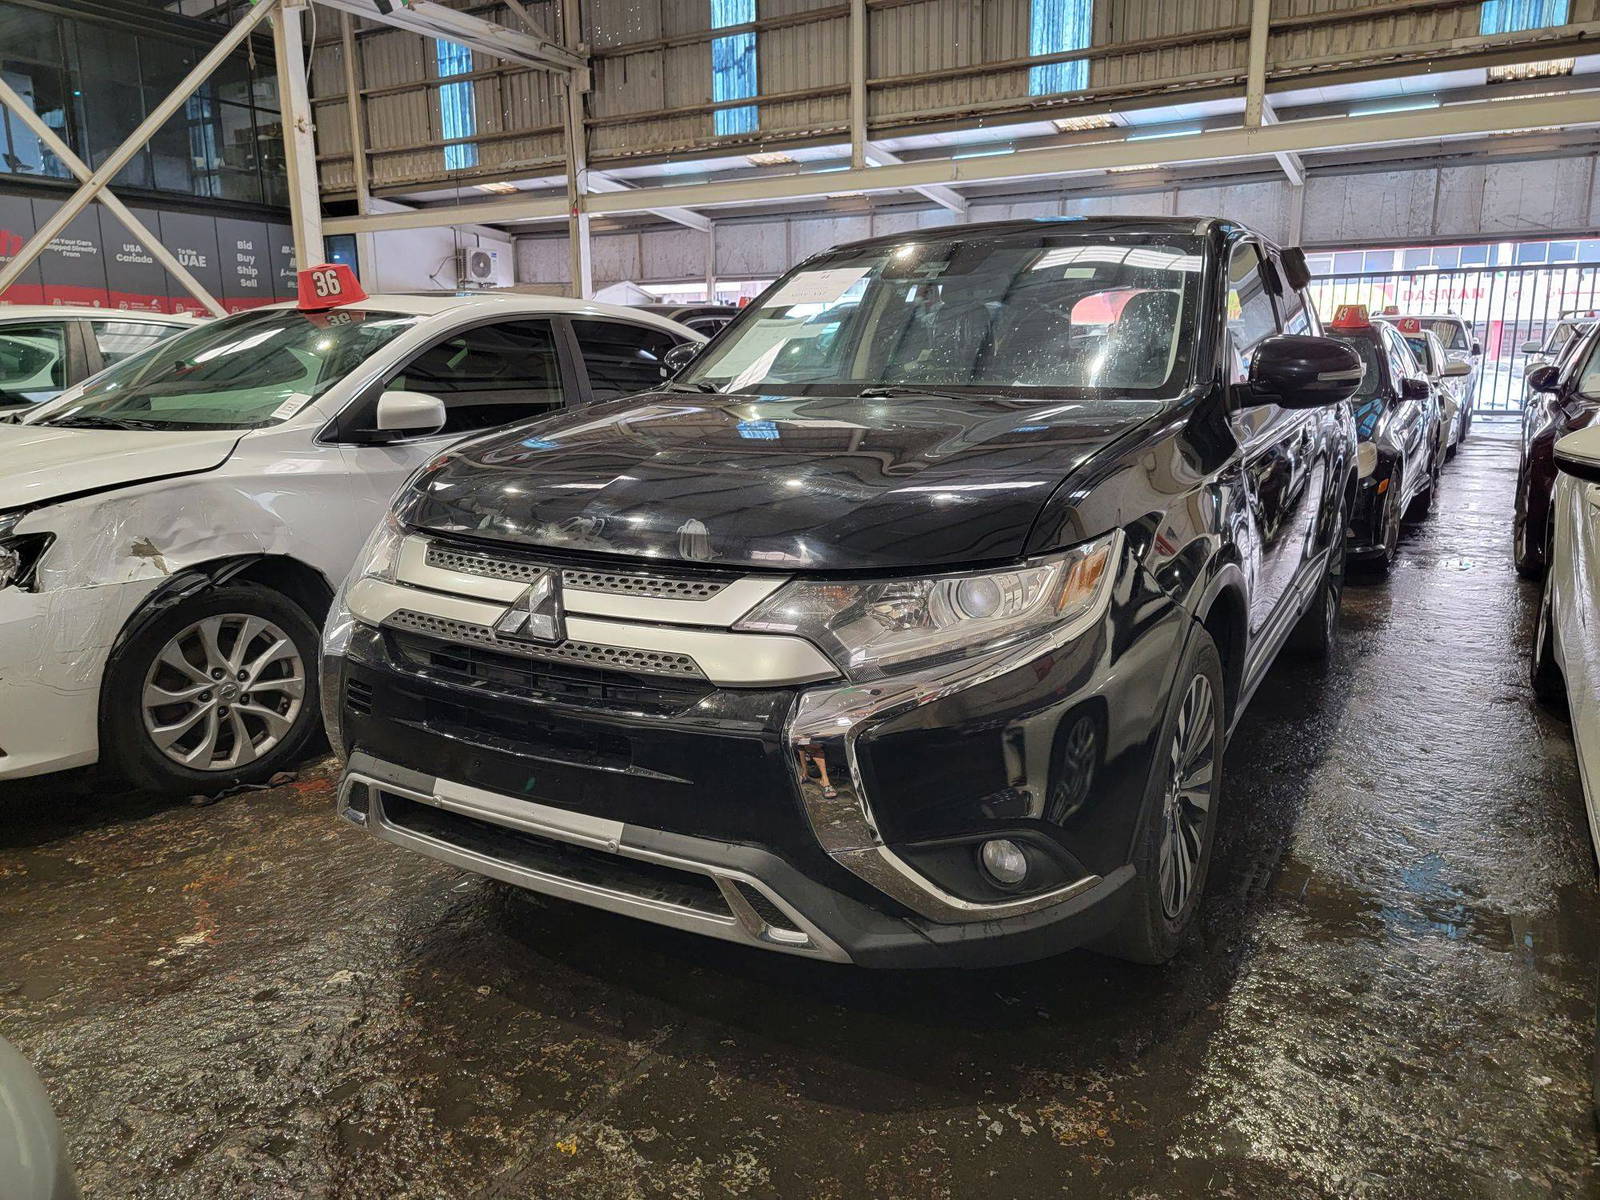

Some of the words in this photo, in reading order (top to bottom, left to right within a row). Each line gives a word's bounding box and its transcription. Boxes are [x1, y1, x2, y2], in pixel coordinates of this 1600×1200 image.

[122, 243, 142, 253] USA
[236, 240, 253, 250] Bid
[116, 253, 153, 264] Canada
[179, 254, 207, 268] UAE
[236, 253, 255, 265] Buy
[237, 265, 258, 278] Ship
[240, 278, 258, 287] Sell
[312, 269, 341, 297] 36
[1402, 287, 1486, 302] DASMAN
[1404, 319, 1415, 330] 42
